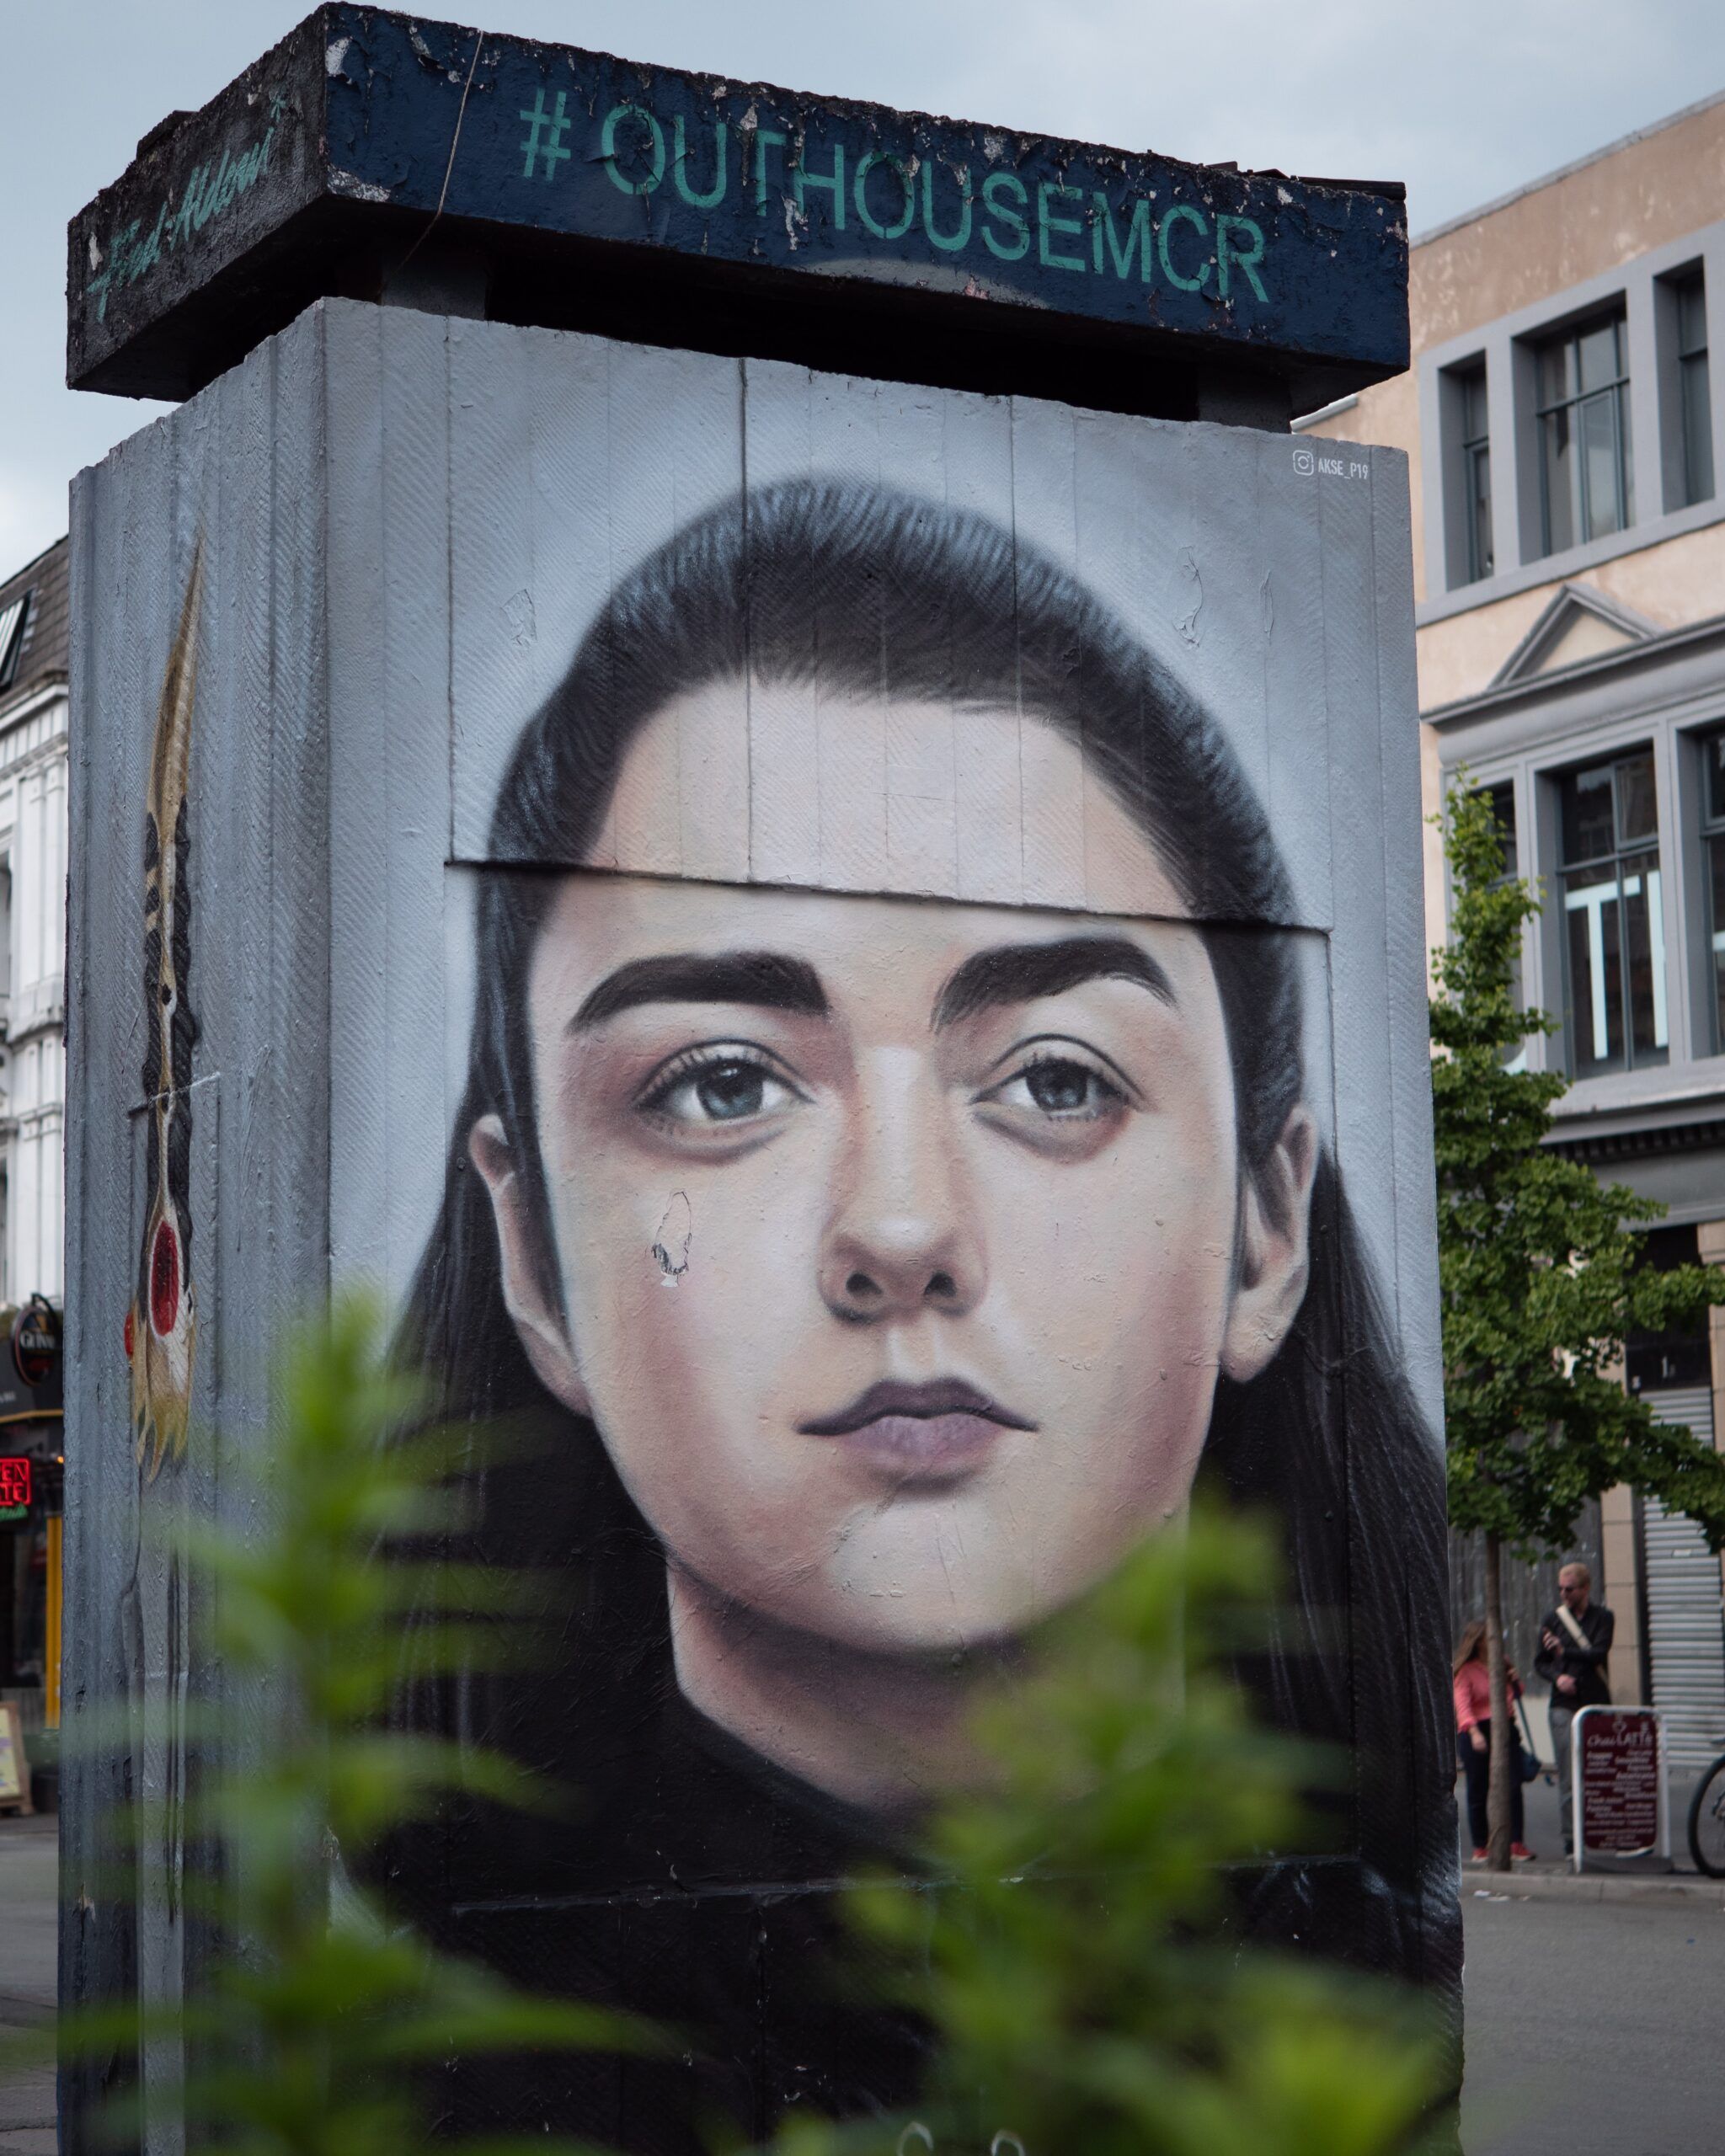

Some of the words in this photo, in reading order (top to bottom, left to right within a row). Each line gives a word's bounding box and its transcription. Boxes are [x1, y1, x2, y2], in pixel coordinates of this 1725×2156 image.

[1318, 457, 1369, 480] AKSE_P19
[0, 1462, 26, 1482] EN
[0, 1482, 24, 1502] TE
